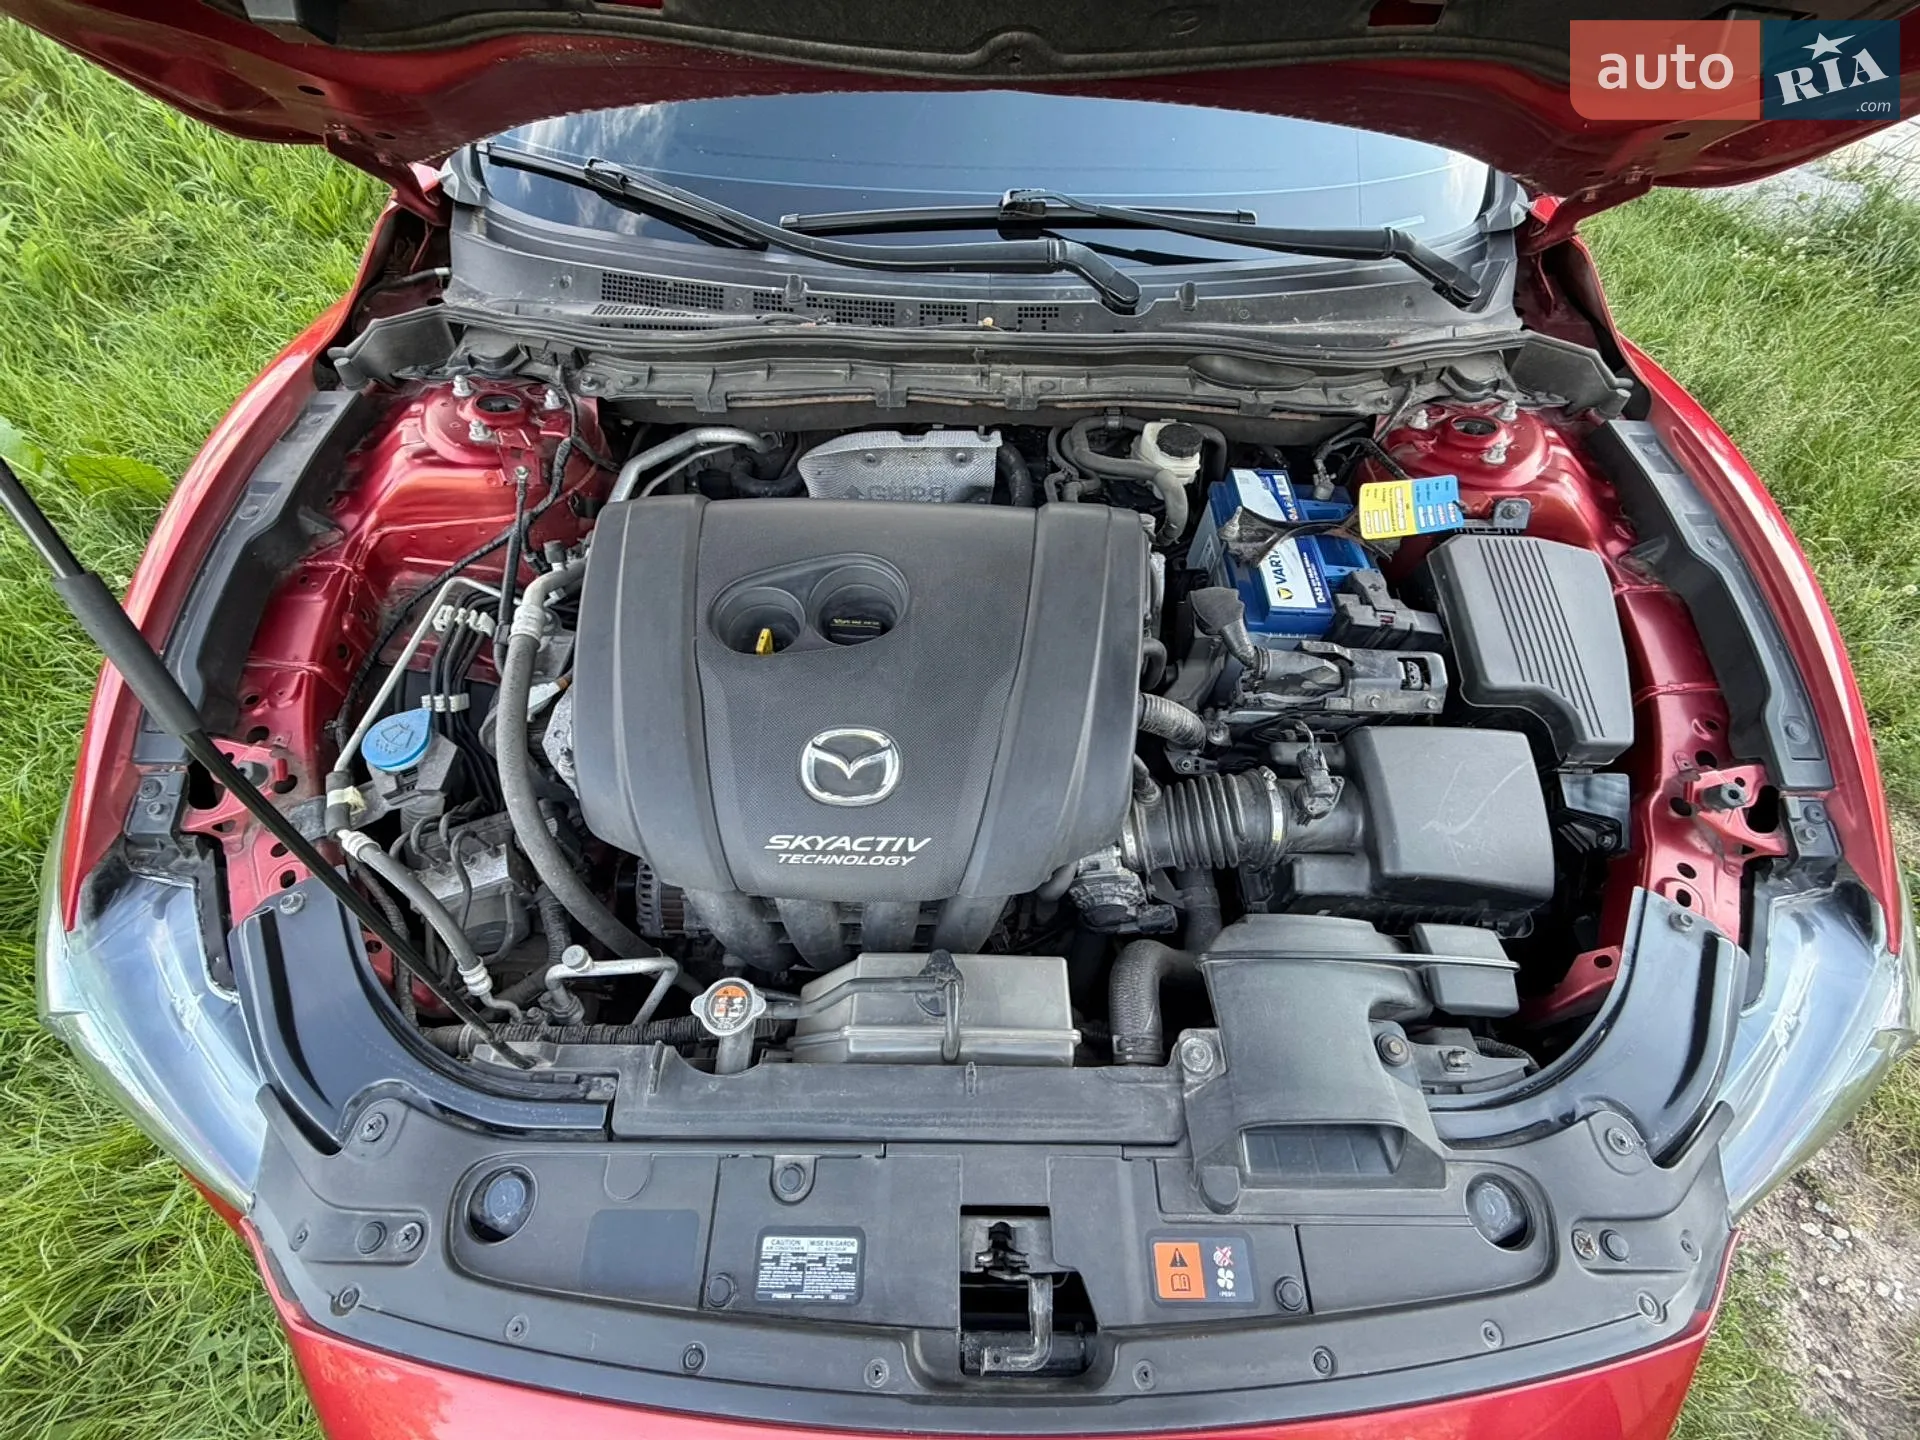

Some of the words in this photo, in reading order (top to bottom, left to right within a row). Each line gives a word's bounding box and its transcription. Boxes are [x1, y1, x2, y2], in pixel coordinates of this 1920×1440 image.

[1268, 550, 1288, 585] VART
[764, 834, 932, 852] SKYACTIV
[777, 853, 916, 866] TECHNOLOGY
